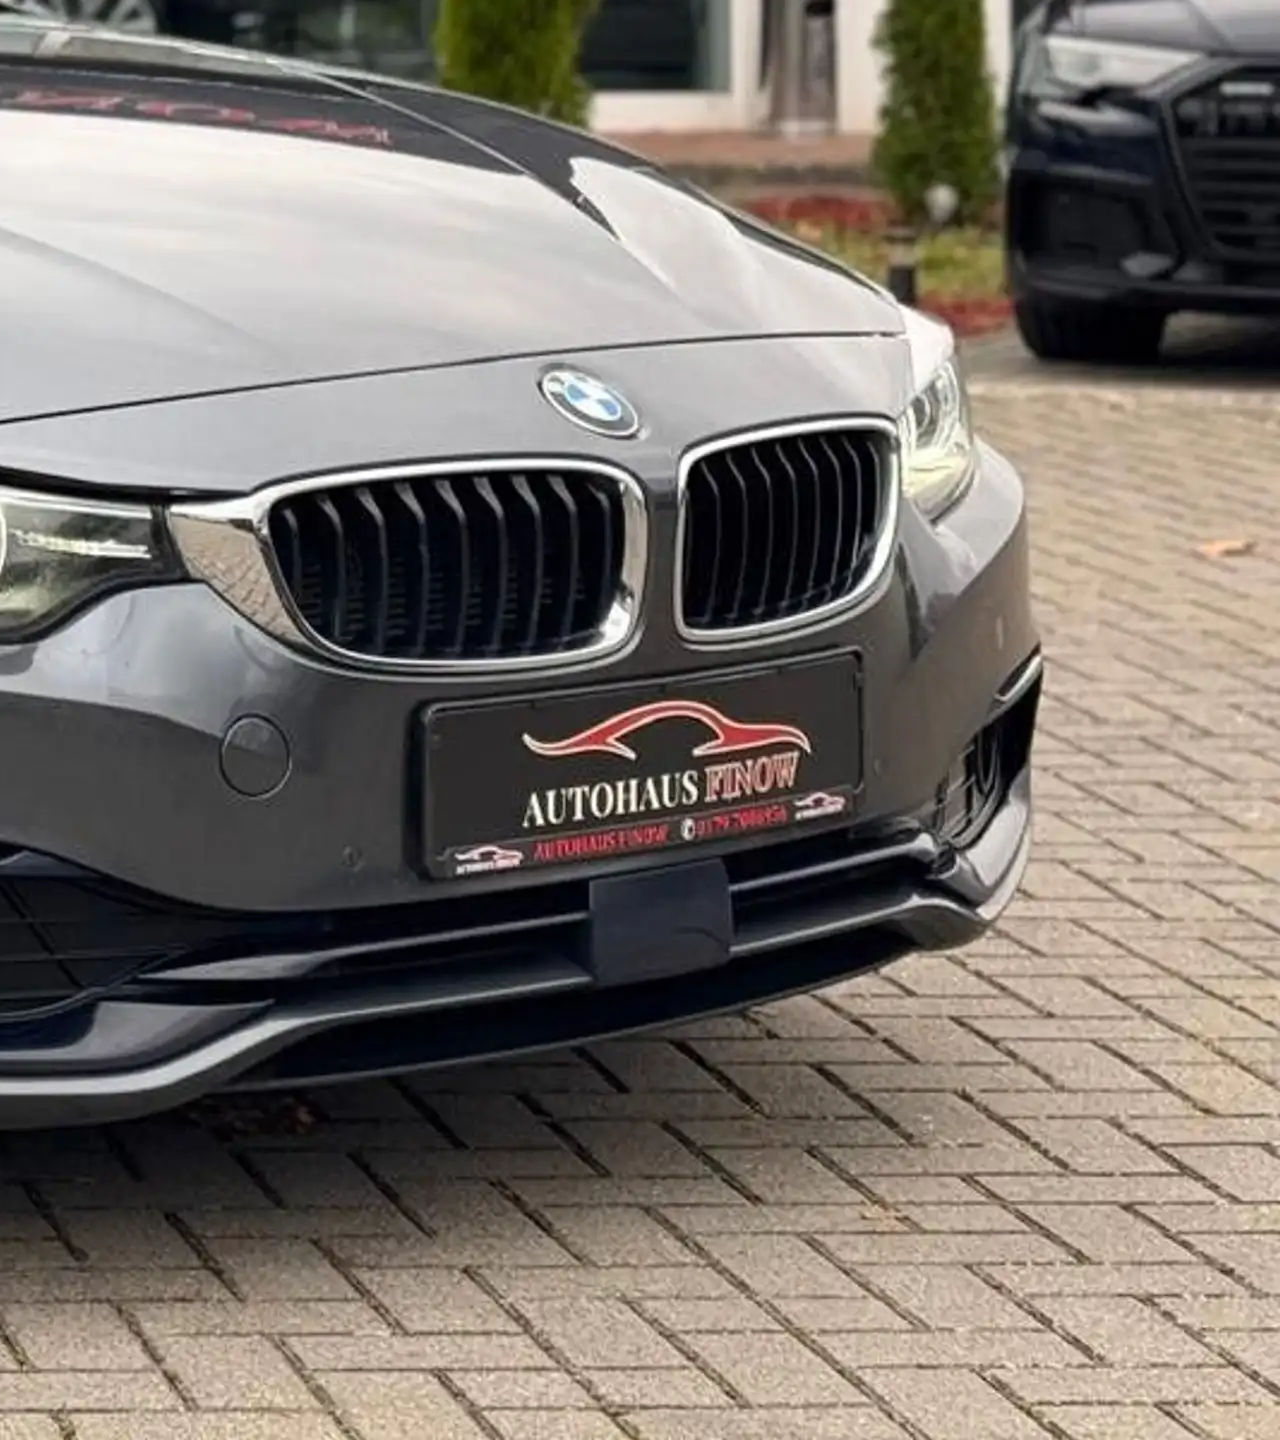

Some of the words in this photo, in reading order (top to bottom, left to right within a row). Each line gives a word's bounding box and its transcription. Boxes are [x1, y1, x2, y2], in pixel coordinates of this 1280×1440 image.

[523, 769, 698, 829] AUTOHAUS
[704, 750, 799, 803] FINOW
[533, 830, 617, 861] AUTOHAUS
[617, 824, 669, 848] FINOW
